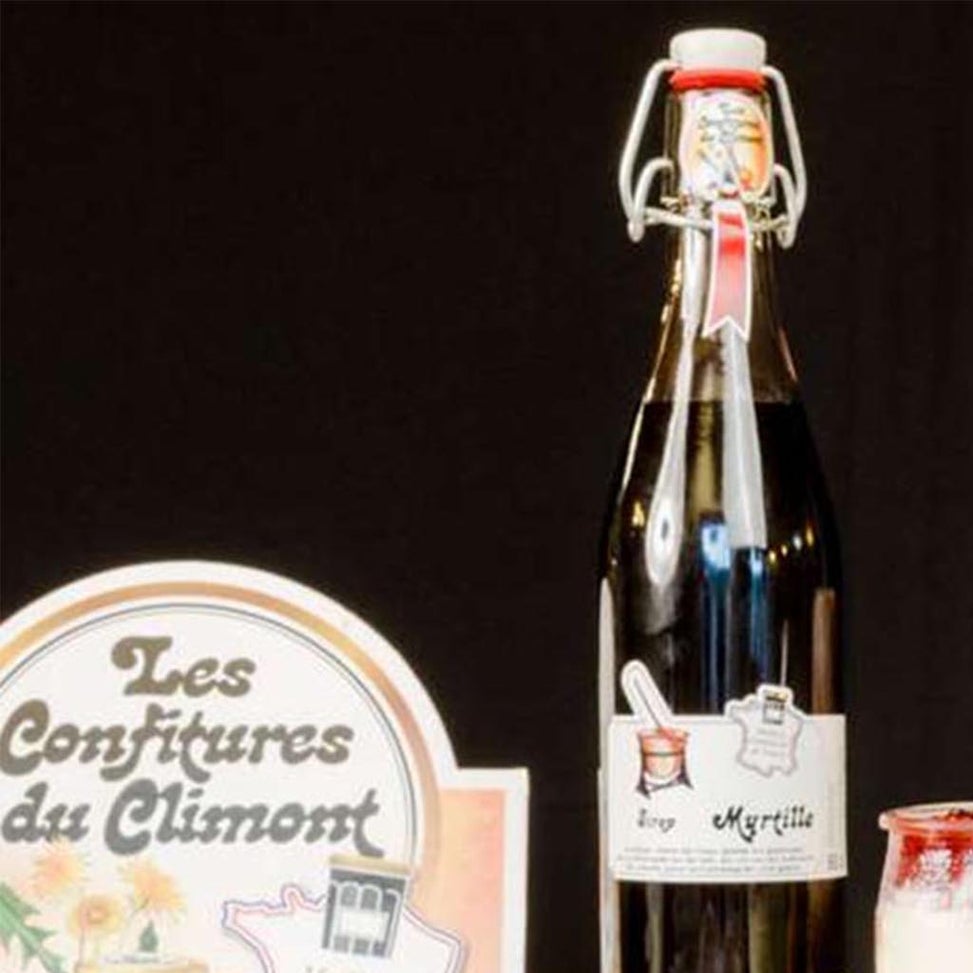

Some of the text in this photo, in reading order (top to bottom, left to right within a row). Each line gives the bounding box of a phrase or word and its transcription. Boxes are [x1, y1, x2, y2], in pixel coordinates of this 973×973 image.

[110, 635, 257, 698] Les
[0, 699, 355, 783] Confitures
[1, 778, 385, 858] du Climont
[712, 804, 814, 844] Myrtille
